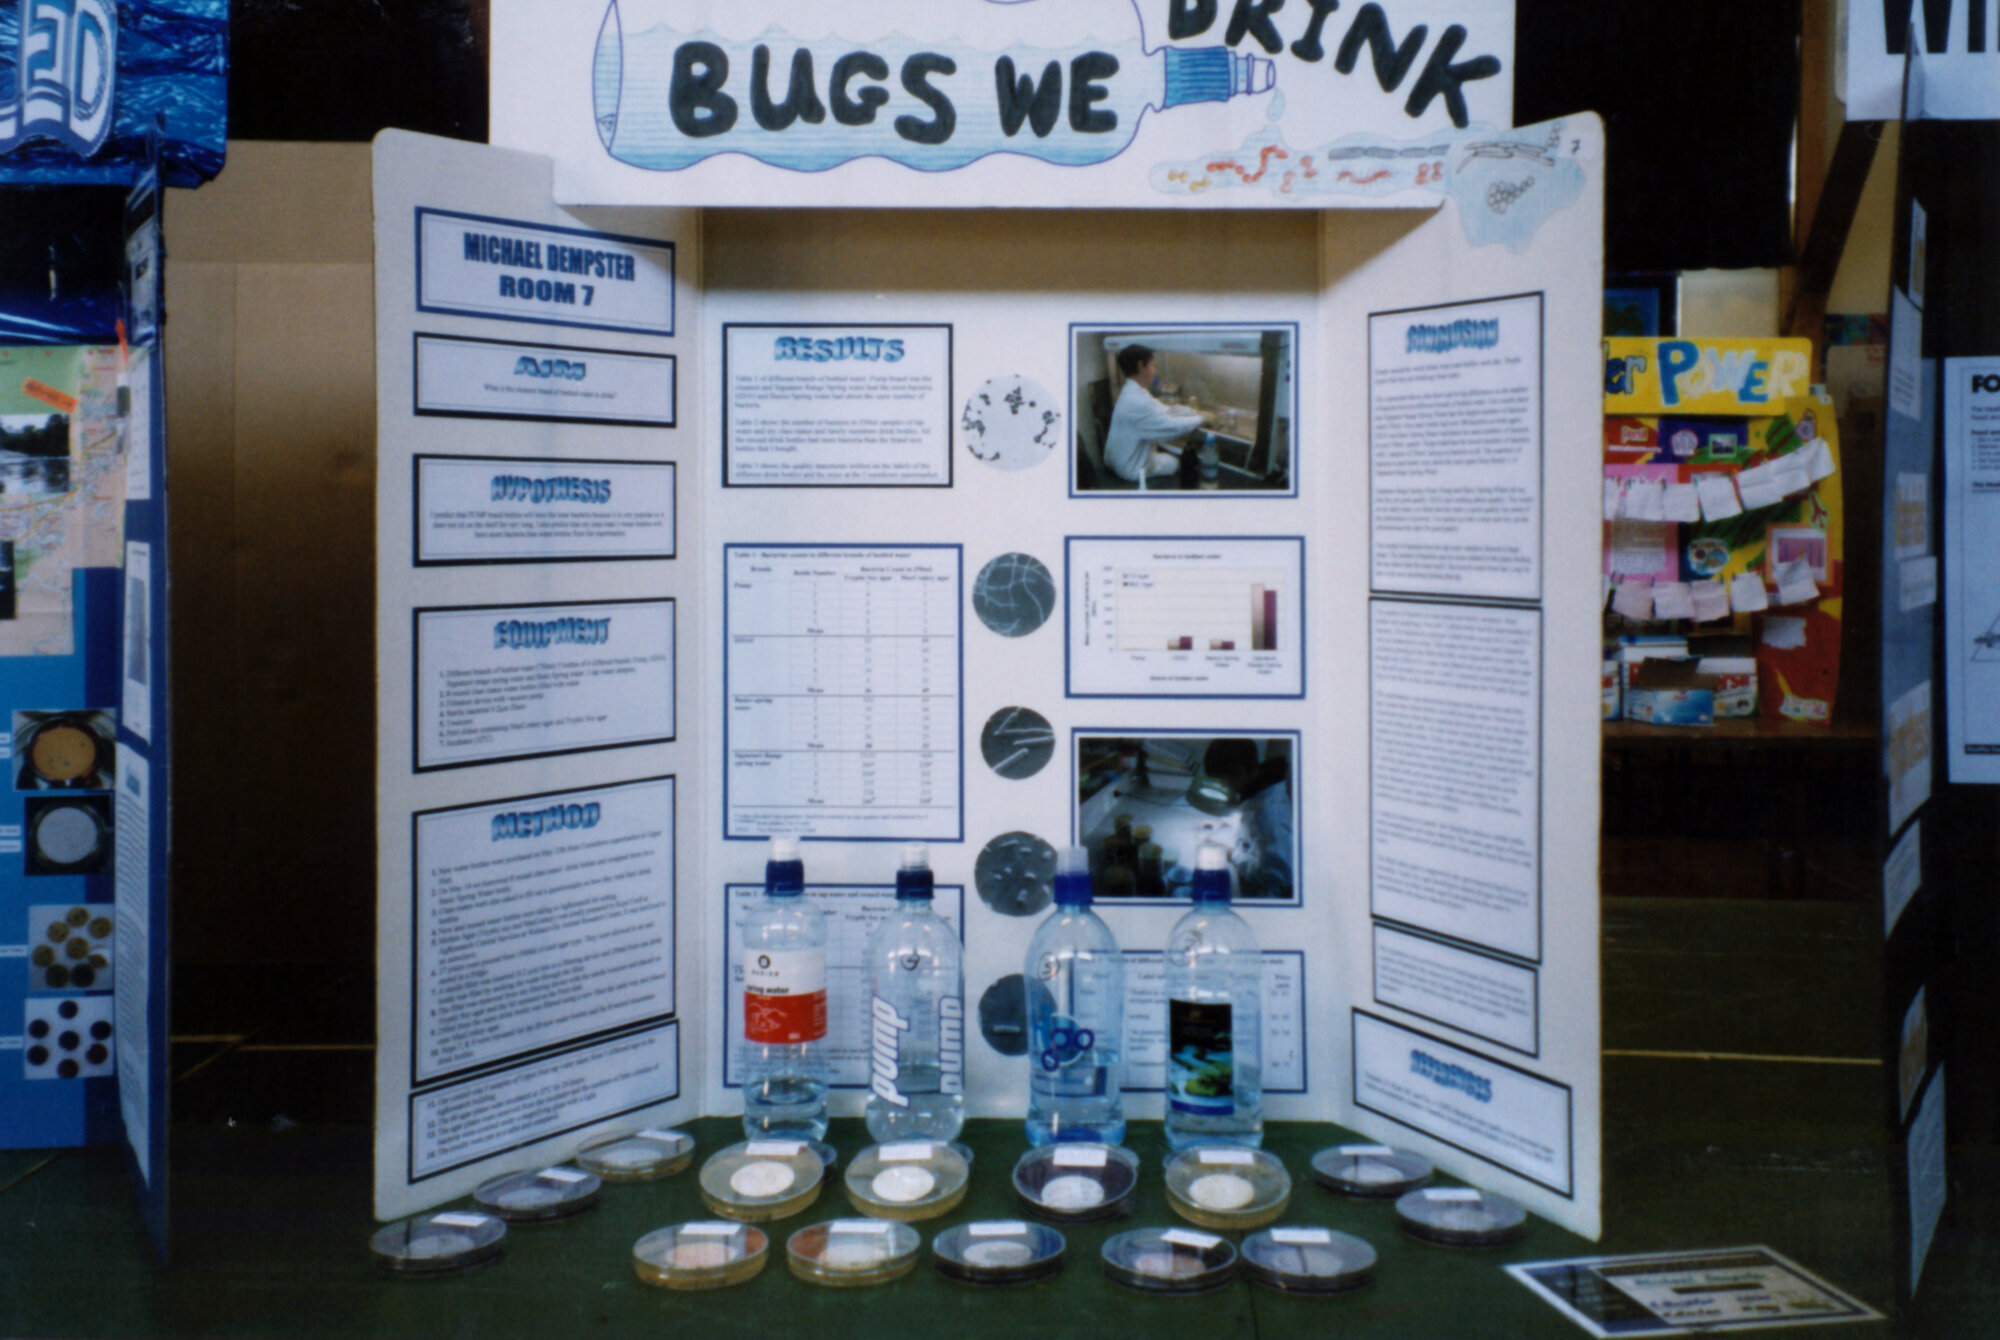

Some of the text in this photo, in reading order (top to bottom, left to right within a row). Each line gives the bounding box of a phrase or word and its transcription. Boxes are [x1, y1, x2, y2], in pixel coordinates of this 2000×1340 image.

[669, 41, 957, 145] BUGS
[995, 51, 1120, 138] WE
[464, 231, 636, 281] MICHAEL DEMPSTER
[499, 274, 595, 306] ROOM 7
[513, 355, 587, 381] AIM
[774, 336, 905, 364] RESULTS
[1603, 341, 1648, 394] er
[491, 475, 612, 504] HYPOTHESIS
[494, 617, 611, 650] EQUIPMENT
[491, 801, 602, 842] METHOD
[872, 993, 911, 1110] pump
